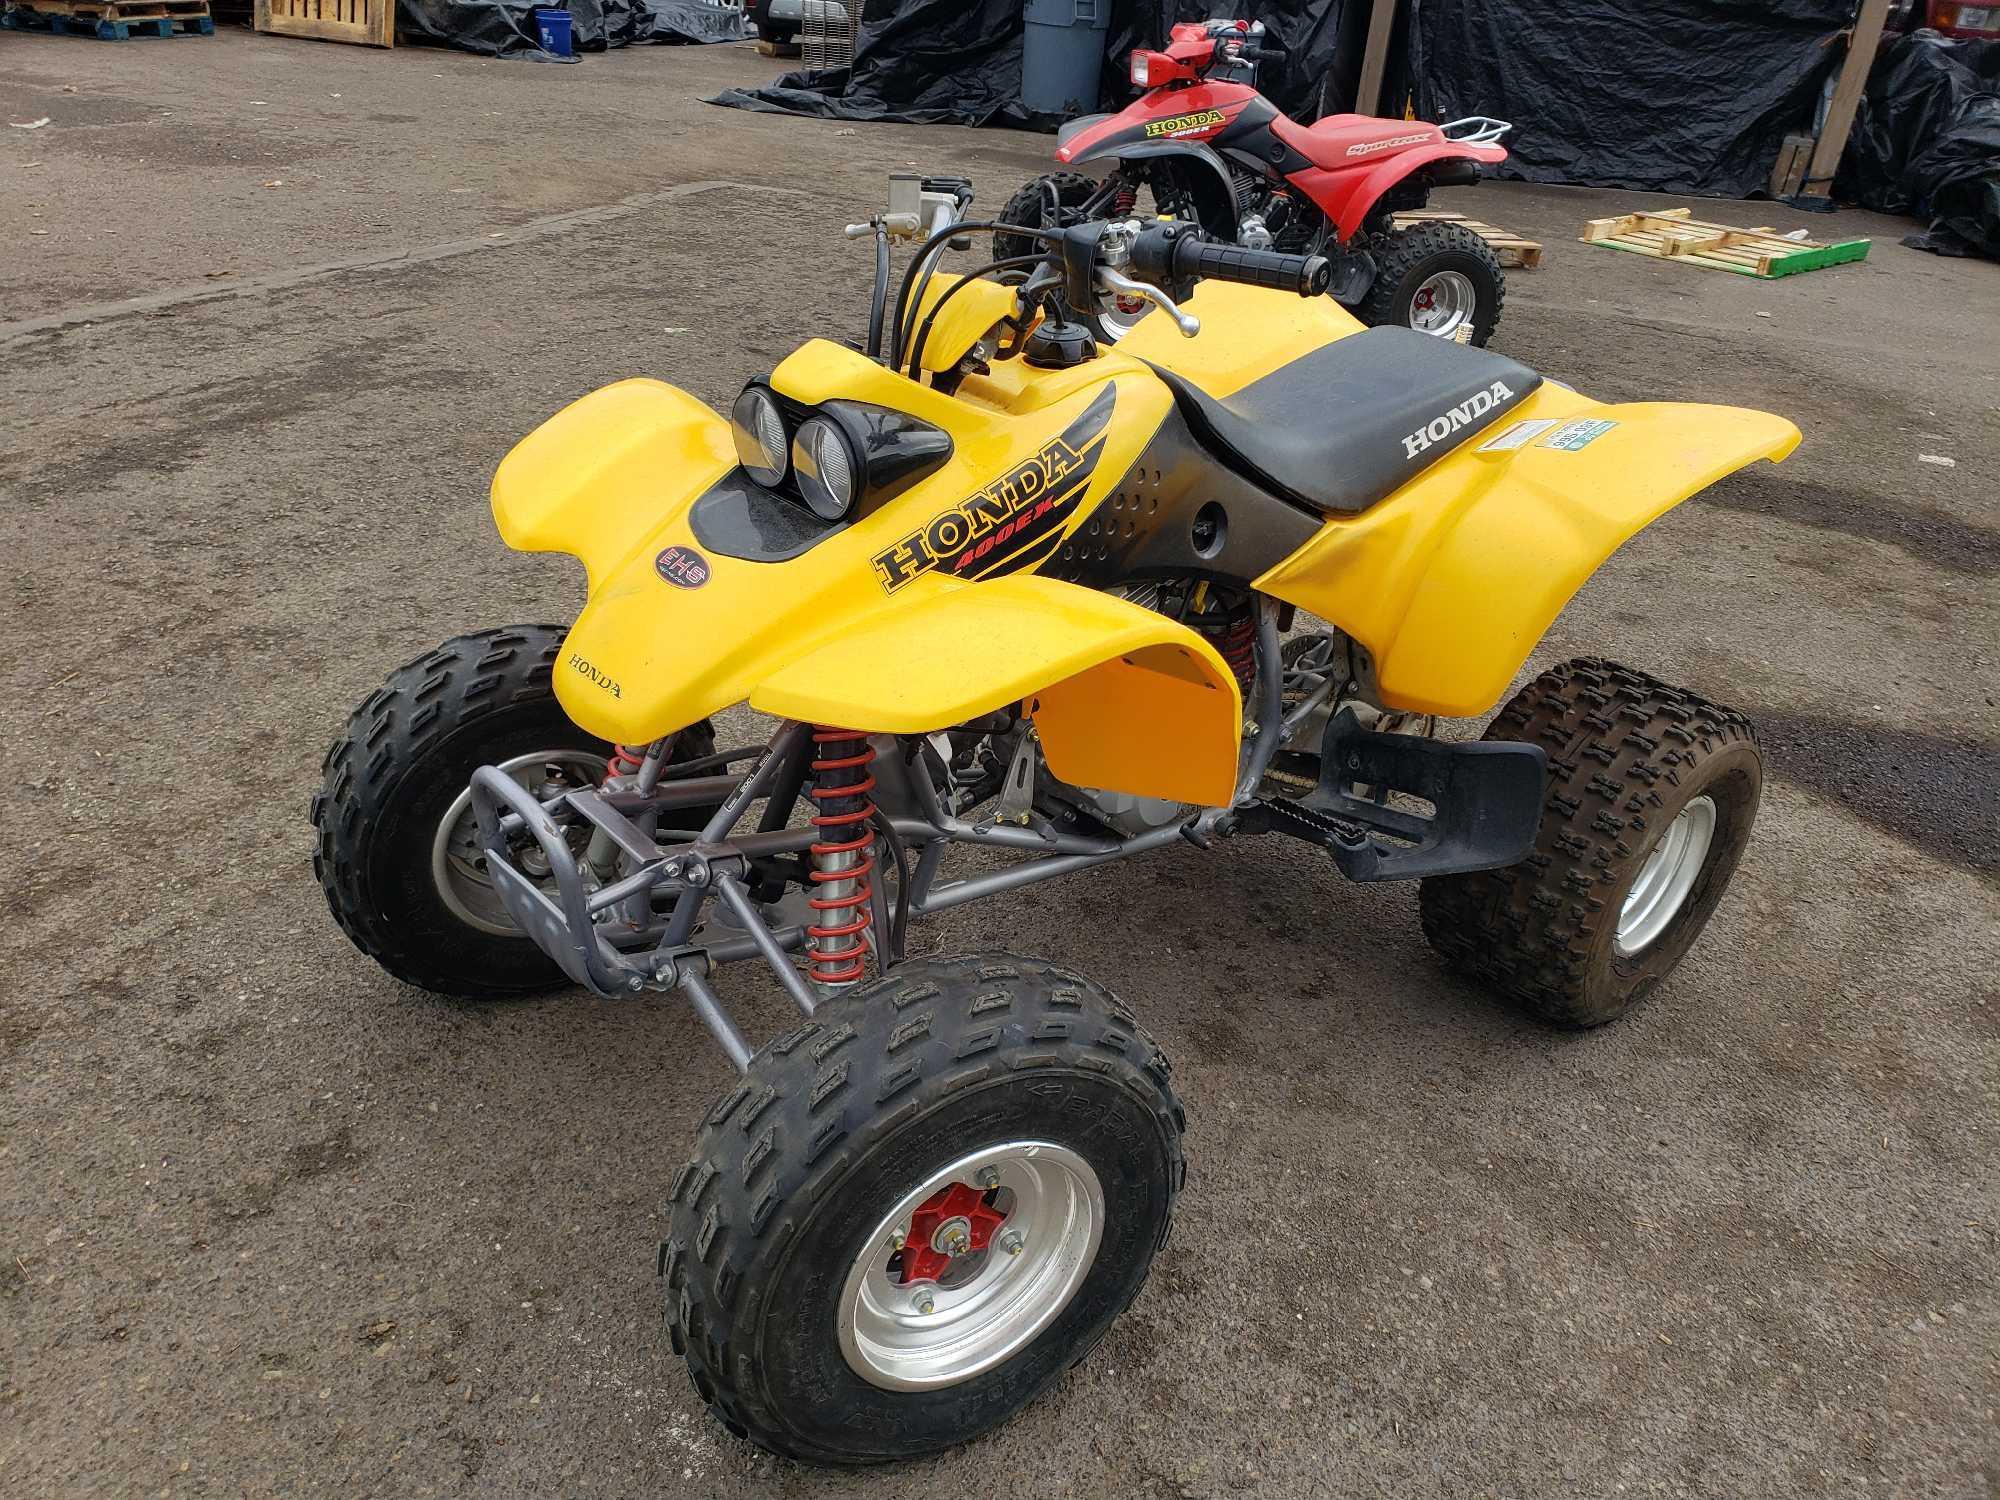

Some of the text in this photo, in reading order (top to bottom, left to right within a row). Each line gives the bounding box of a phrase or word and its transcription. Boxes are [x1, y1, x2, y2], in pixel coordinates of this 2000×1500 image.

[1145, 110, 1226, 137] HONDA
[1401, 380, 1514, 461] HONDA
[871, 435, 1086, 597] HONDA
[953, 495, 1055, 571] 400EX
[568, 653, 623, 699] HONDA
